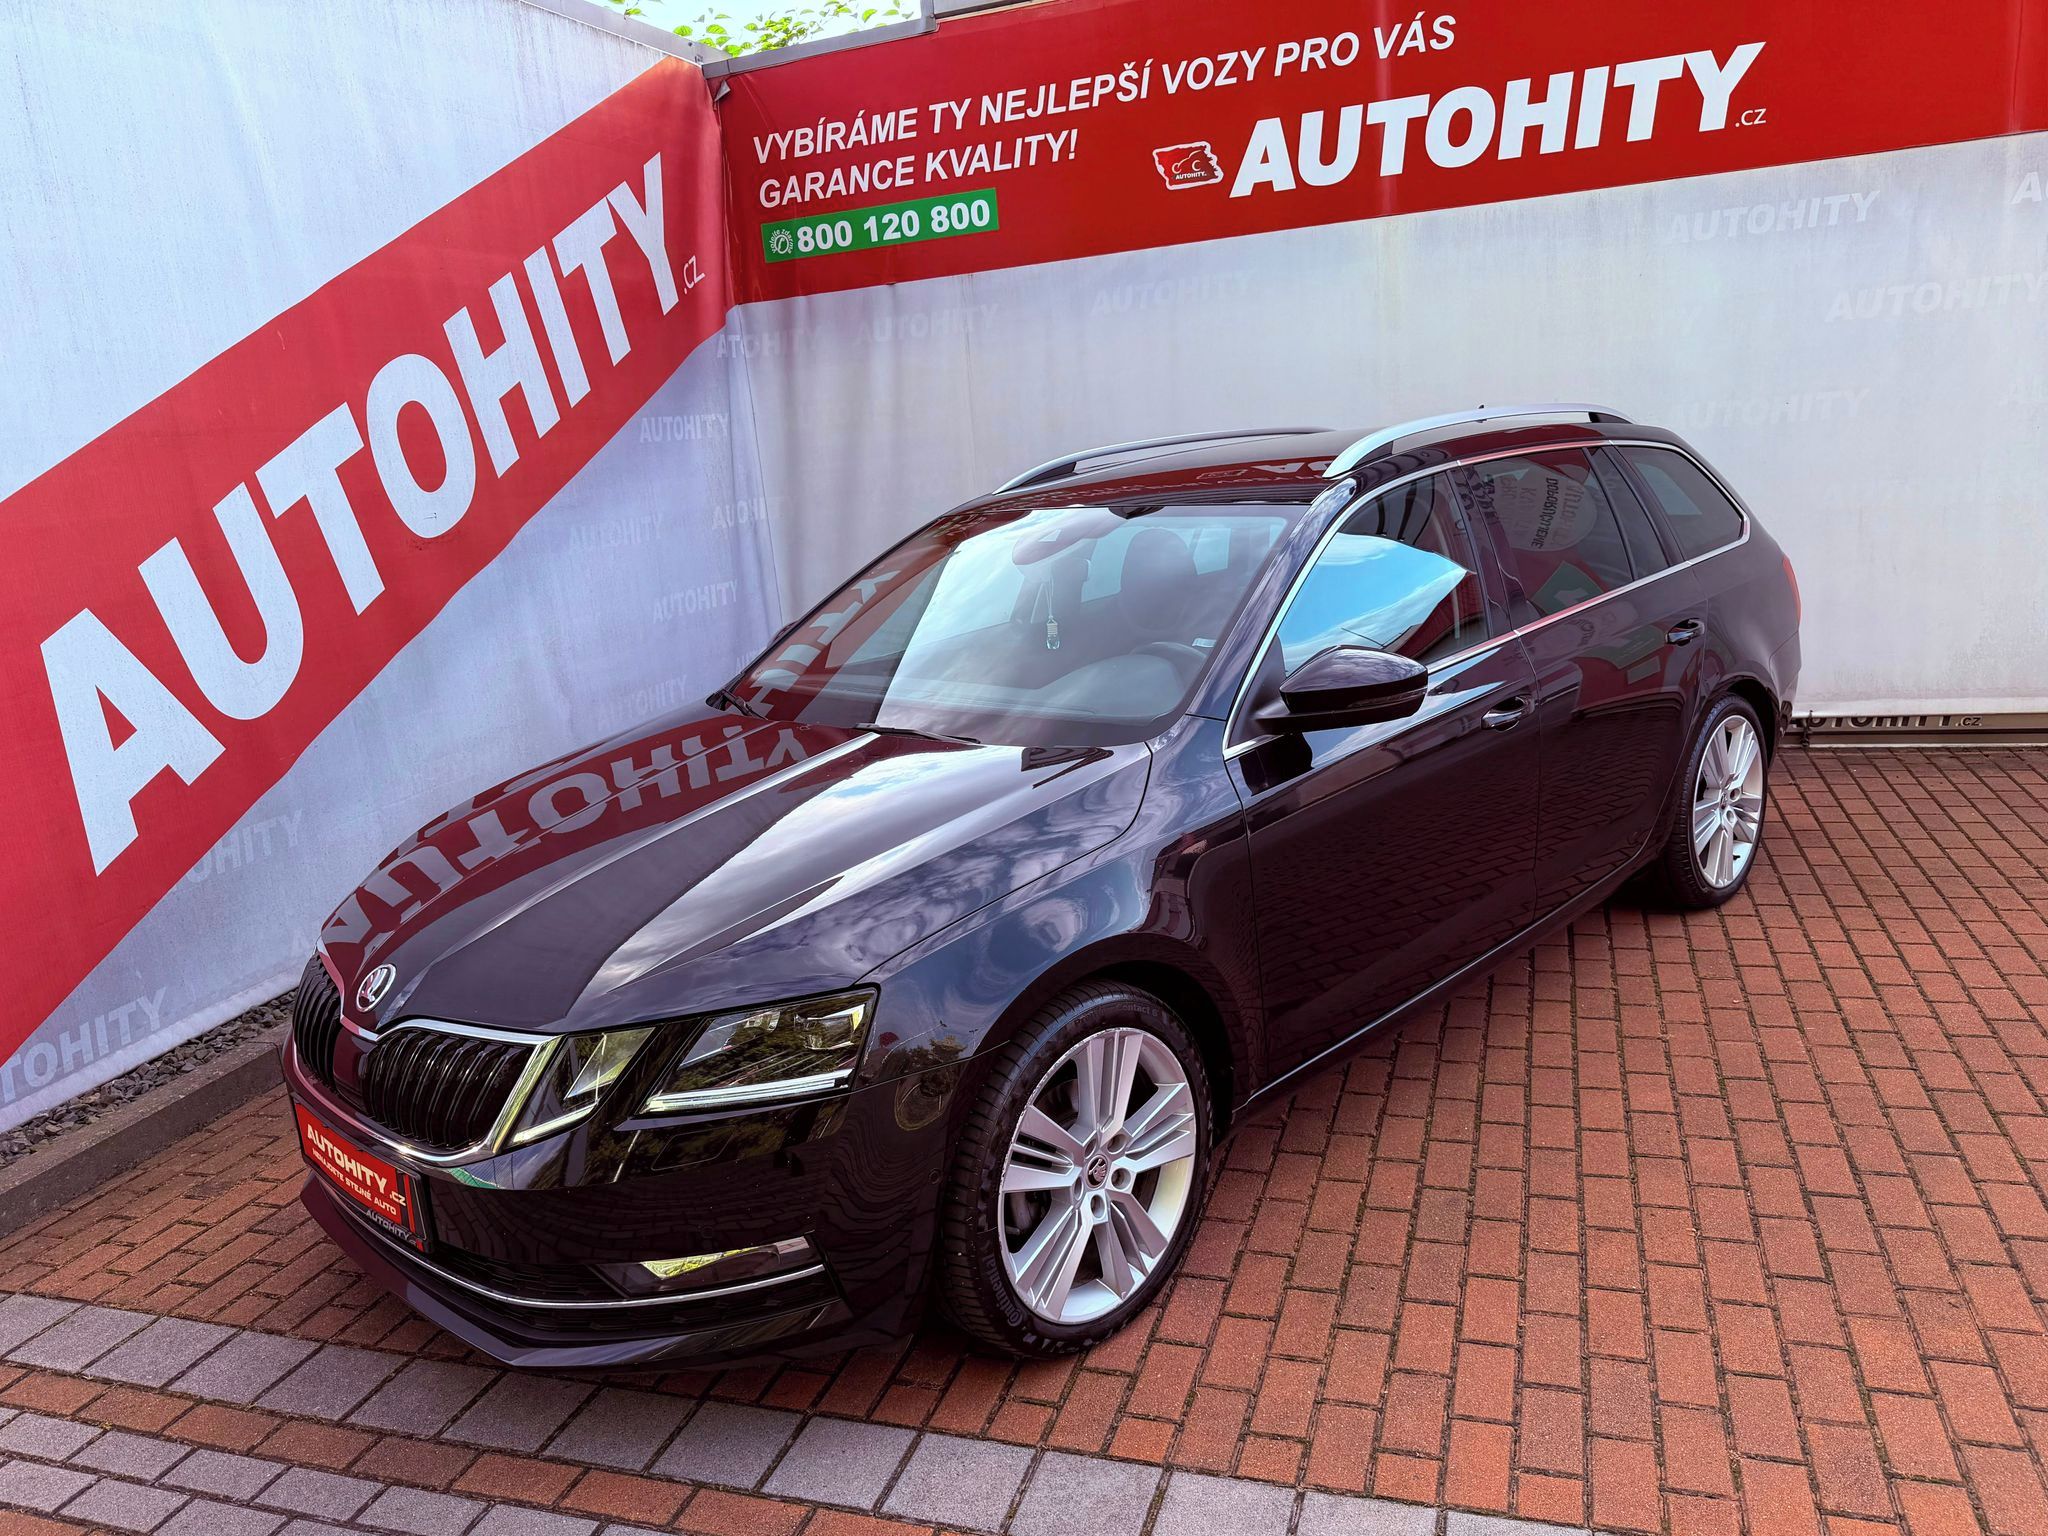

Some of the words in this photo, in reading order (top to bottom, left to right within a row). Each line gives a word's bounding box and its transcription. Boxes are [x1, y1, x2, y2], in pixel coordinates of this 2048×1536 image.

[753, 107, 918, 165] VYBÍRÁME
[929, 98, 972, 135] TY
[979, 58, 1154, 126] NEJLEPŠÍ
[1161, 46, 1267, 95] VOZY
[1274, 31, 1361, 77] PRO
[1373, 11, 1457, 60] VÁS
[1229, 41, 1766, 199] AUTOHITY
[759, 154, 915, 209] GARANCE
[924, 128, 1078, 184] KVALITY!
[796, 220, 854, 253] 800
[863, 209, 920, 243] 120
[930, 199, 991, 233] 800
[639, 412, 731, 444] AUTOHITY
[42, 151, 680, 875] AUTOHITY
[307, 1123, 388, 1195] AUTOHITY
[365, 1208, 412, 1241] AUTOHITY
[373, 1196, 397, 1216] AUTO
